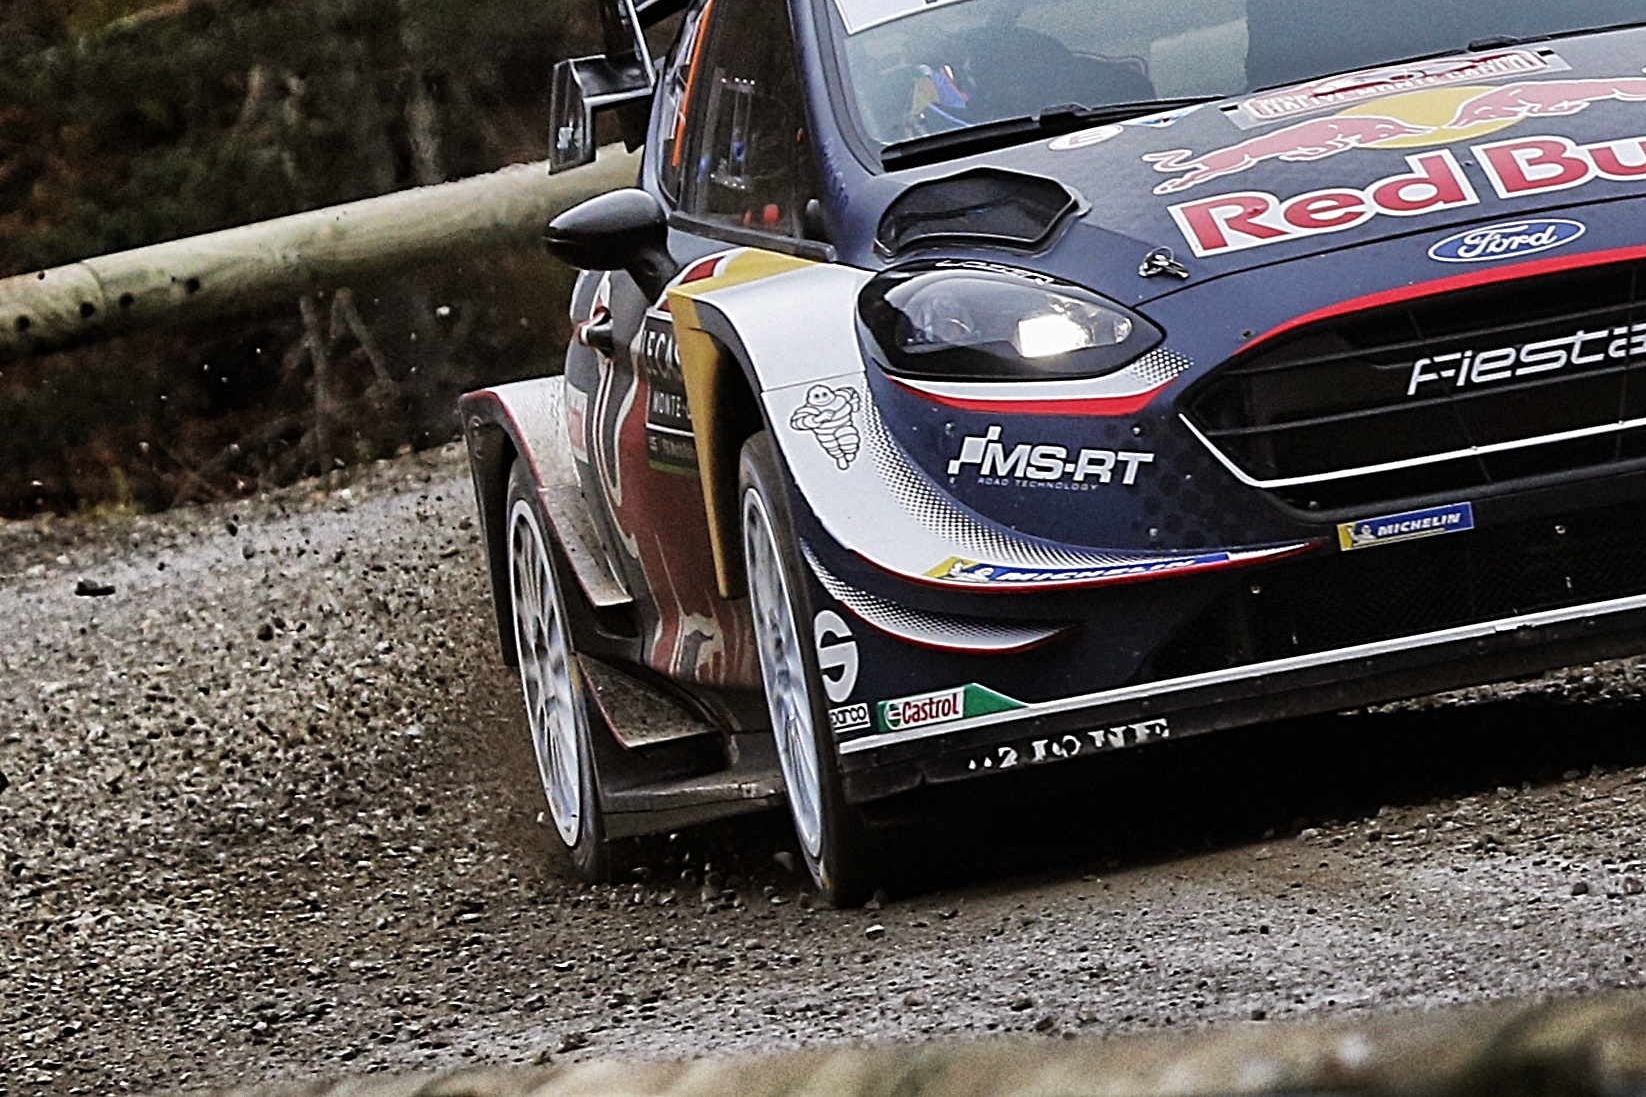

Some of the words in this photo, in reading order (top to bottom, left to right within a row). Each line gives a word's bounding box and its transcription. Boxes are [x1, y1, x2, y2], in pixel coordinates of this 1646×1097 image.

[1176, 151, 1468, 253] Red
[1457, 225, 1558, 258] Ford
[1377, 512, 1461, 537] MICHELIN
[902, 692, 960, 725] Castrol
